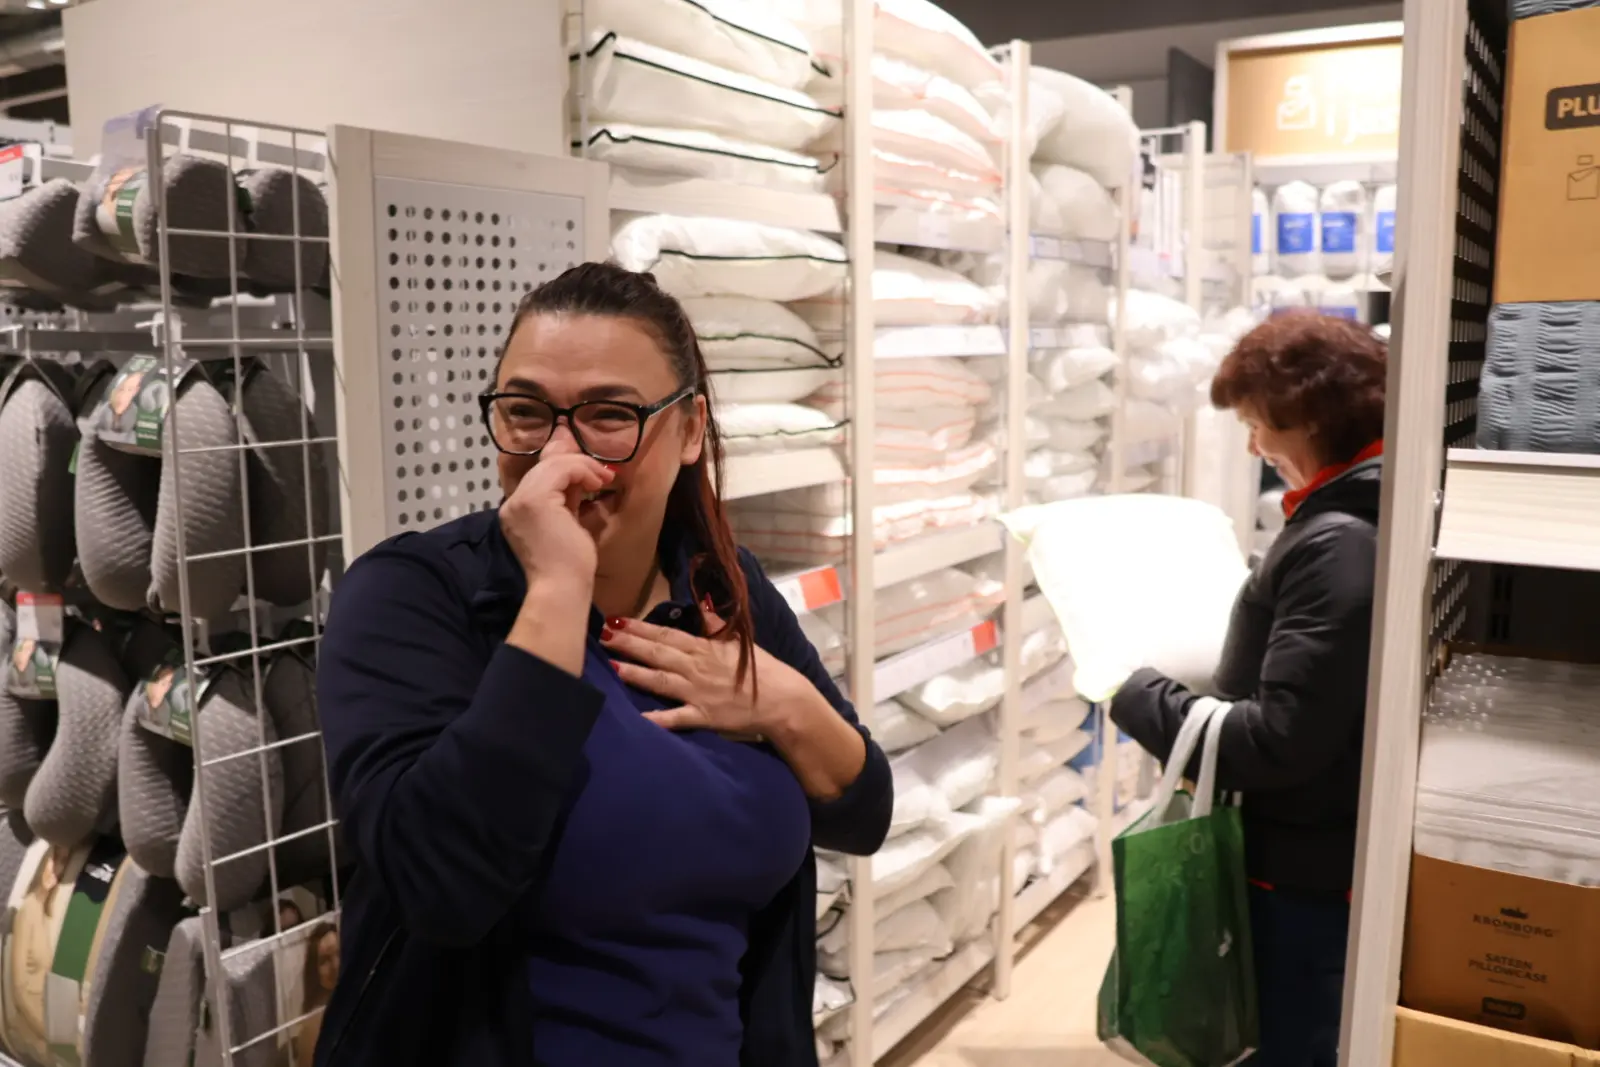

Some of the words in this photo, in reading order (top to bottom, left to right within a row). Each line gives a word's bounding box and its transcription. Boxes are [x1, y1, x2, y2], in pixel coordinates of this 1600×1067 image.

[1472, 914, 1554, 937] KRONBORG
[1468, 959, 1547, 983] PILLOWCASE
[1485, 953, 1533, 969] SATEEN
